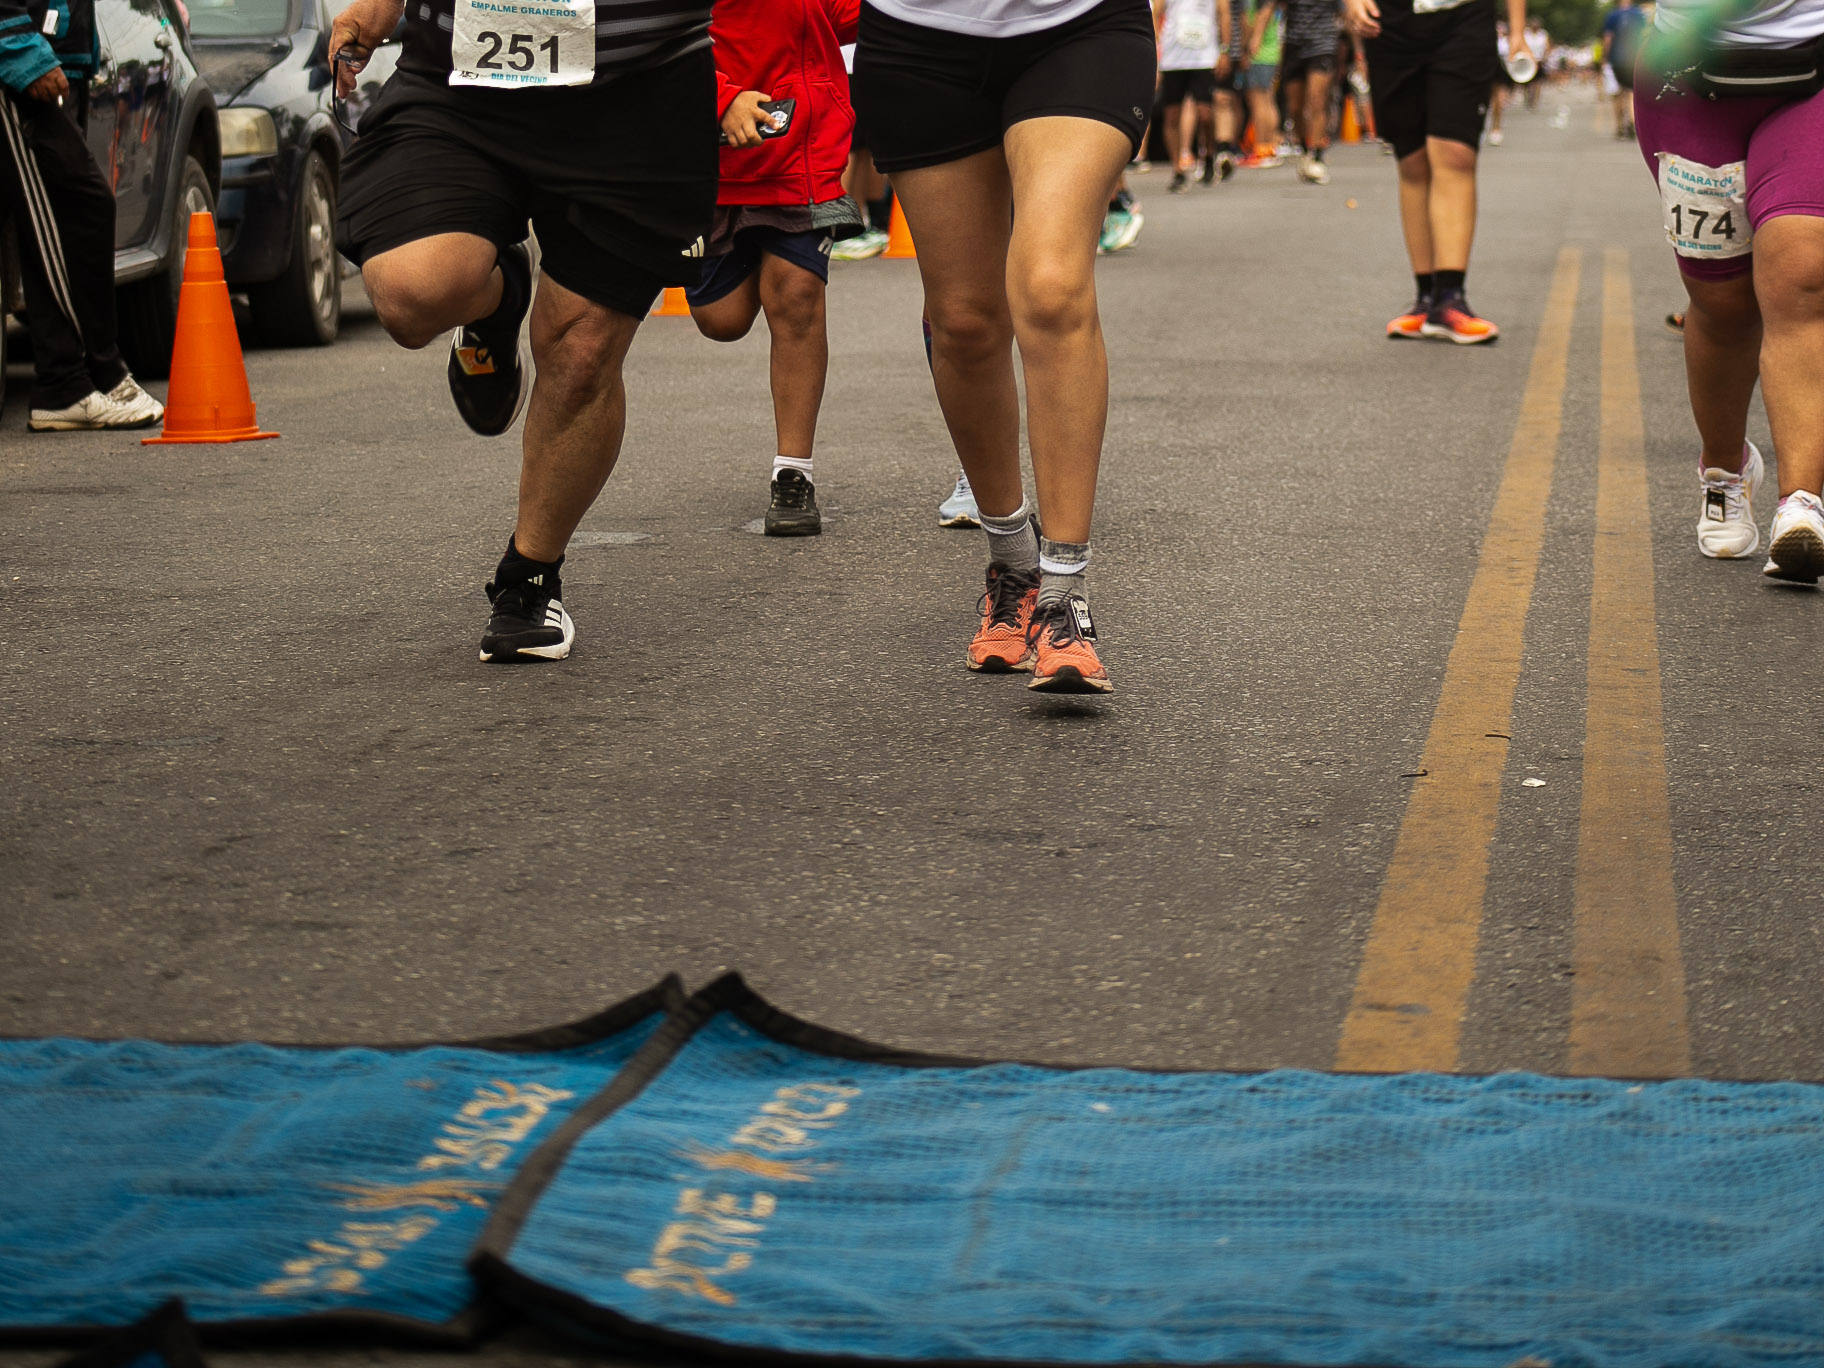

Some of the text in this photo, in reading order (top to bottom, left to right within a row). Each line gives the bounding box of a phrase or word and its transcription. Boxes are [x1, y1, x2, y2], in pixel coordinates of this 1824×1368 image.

[471, 0, 577, 17] EMPALME GRANEROS
[476, 31, 559, 73] 251
[1668, 165, 1732, 188] 40 MARATON
[1671, 204, 1736, 240] 174
